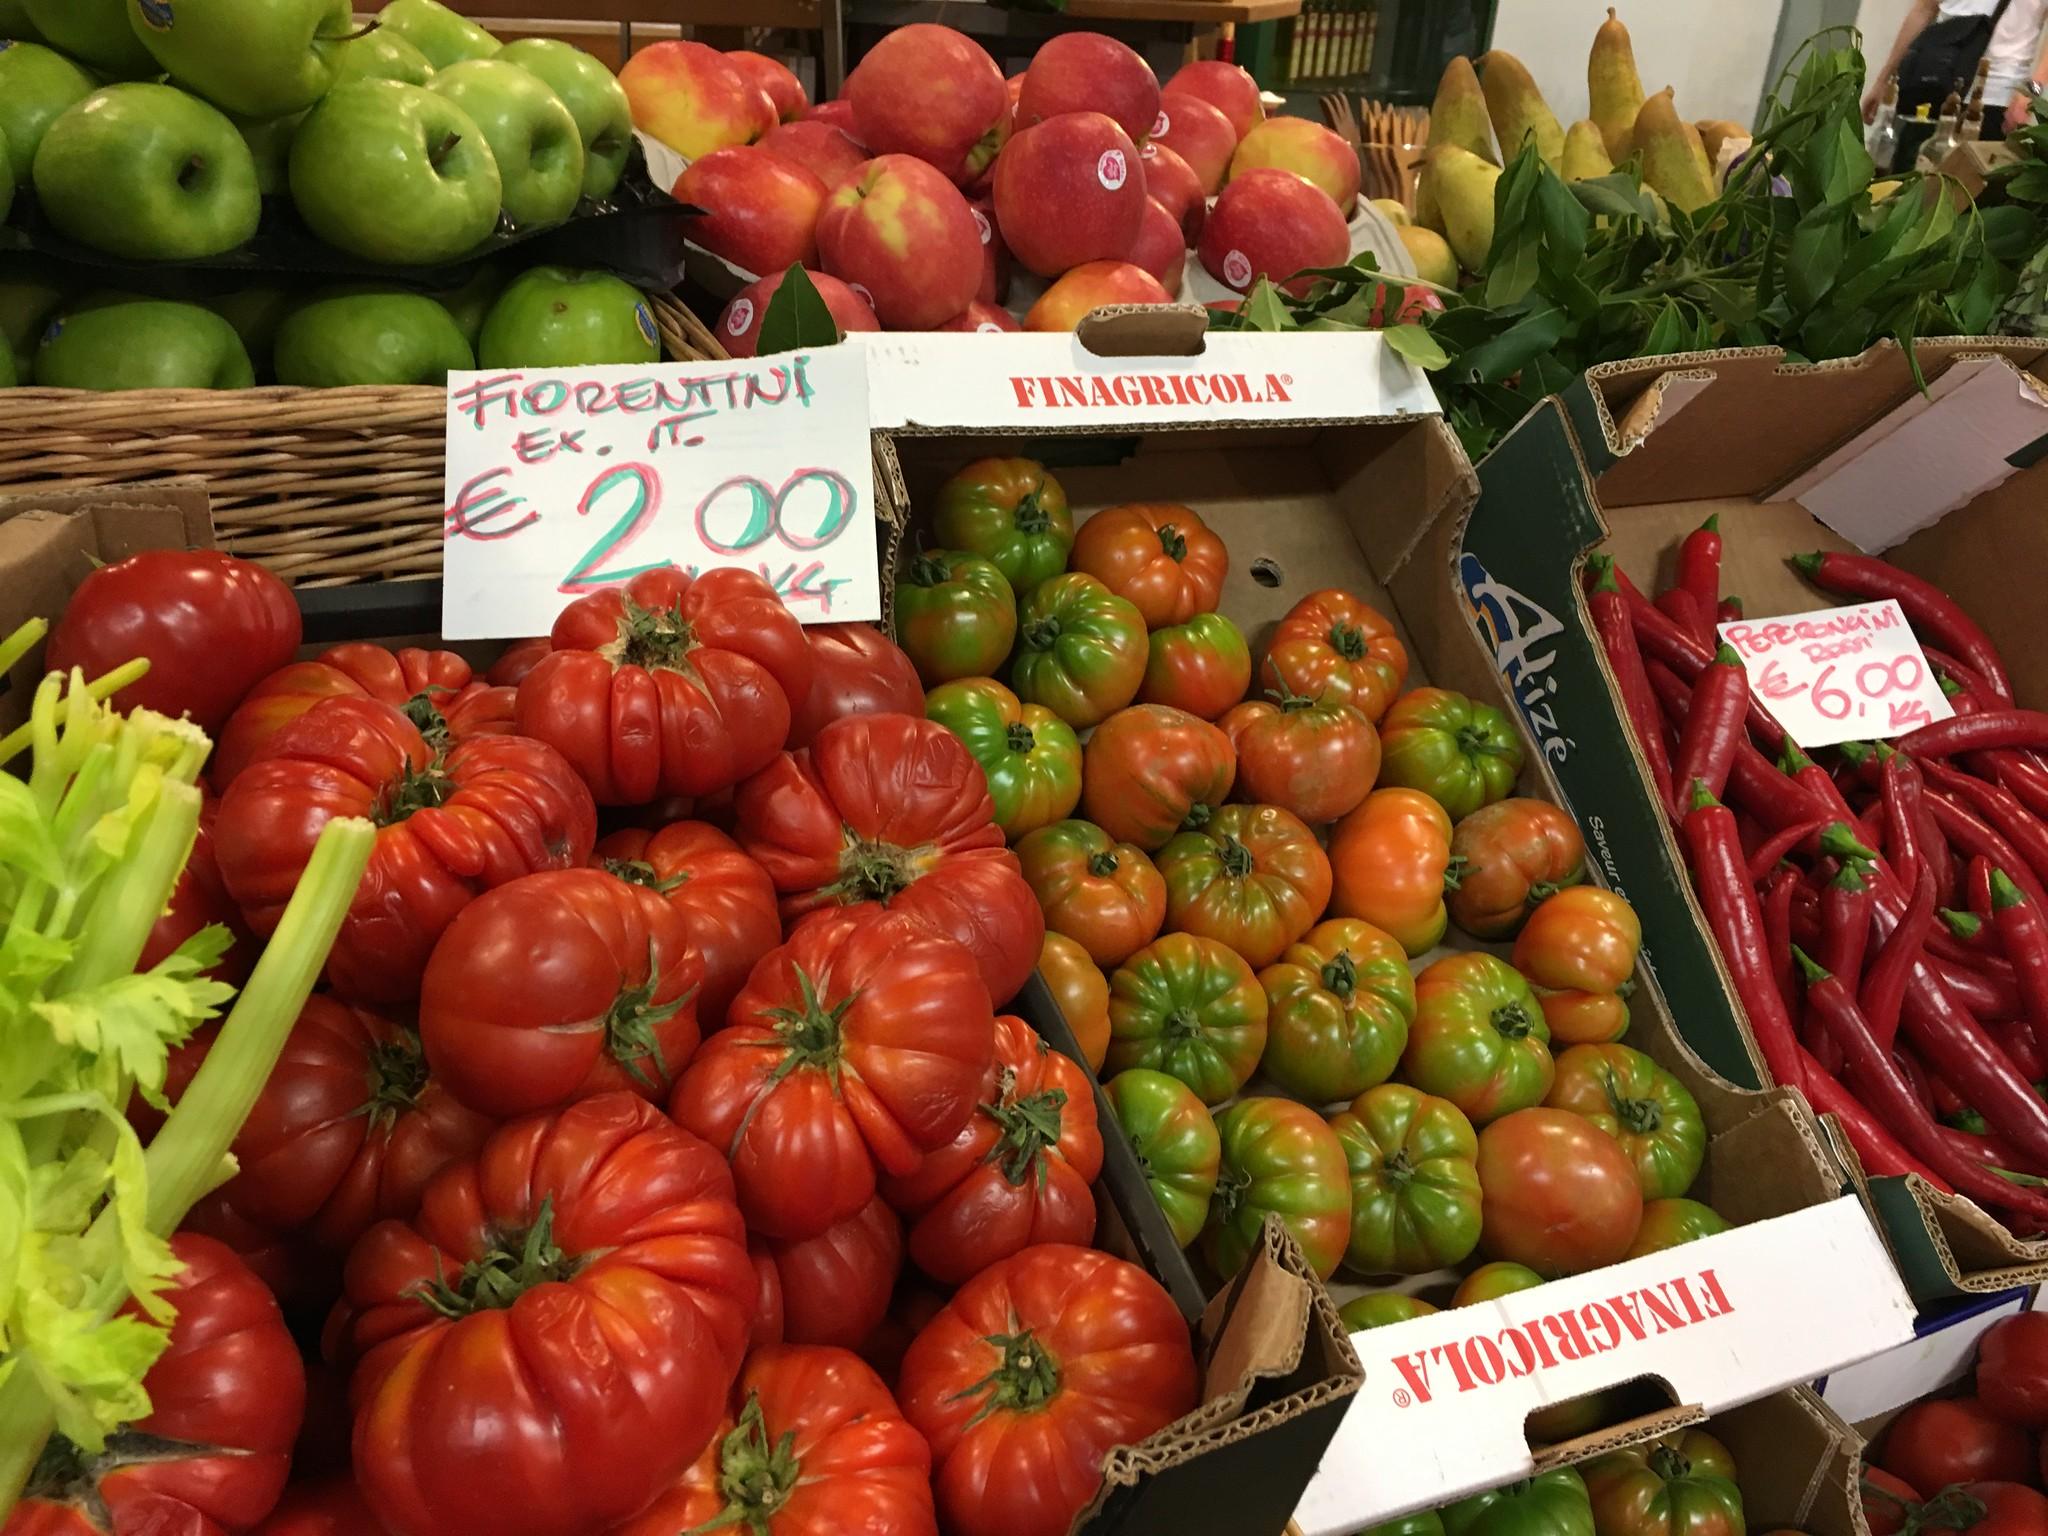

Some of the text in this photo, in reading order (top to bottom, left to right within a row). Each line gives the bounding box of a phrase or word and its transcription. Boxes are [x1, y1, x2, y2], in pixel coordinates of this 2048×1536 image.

[452, 355, 815, 430] FIORENTINI
[444, 466, 542, 541] €
[1754, 654, 1923, 720] € 6,00
[1589, 815, 1621, 883] Saveur
